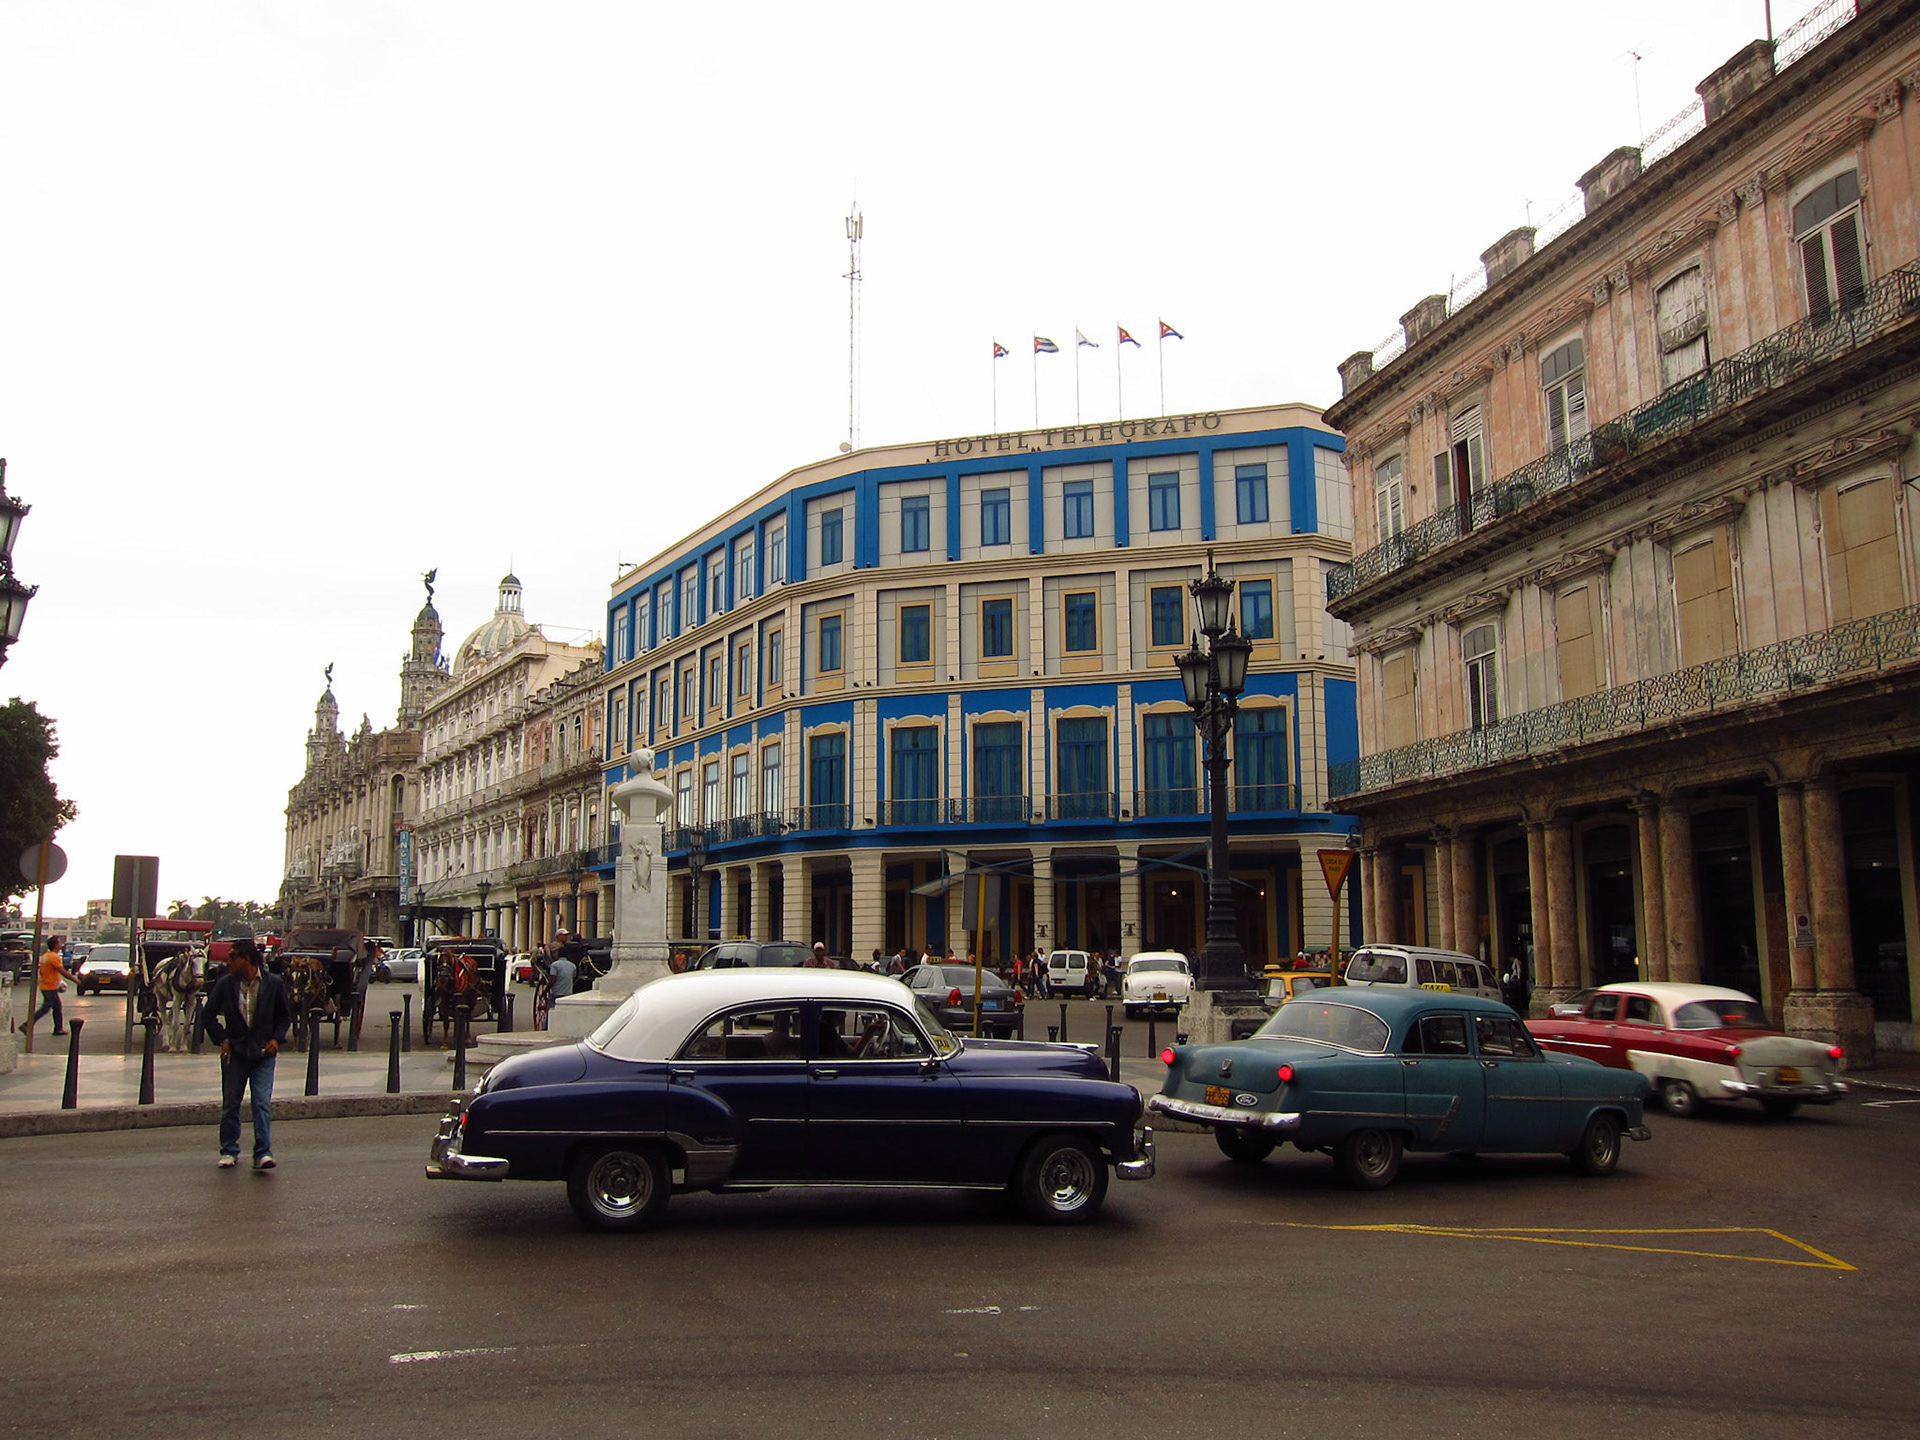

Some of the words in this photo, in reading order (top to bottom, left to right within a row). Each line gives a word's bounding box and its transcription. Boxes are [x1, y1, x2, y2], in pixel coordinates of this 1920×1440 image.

[934, 432, 1029, 457] HOTEL
[1040, 411, 1221, 446] TELEGRAFO
[400, 833, 408, 919] INGLATER
